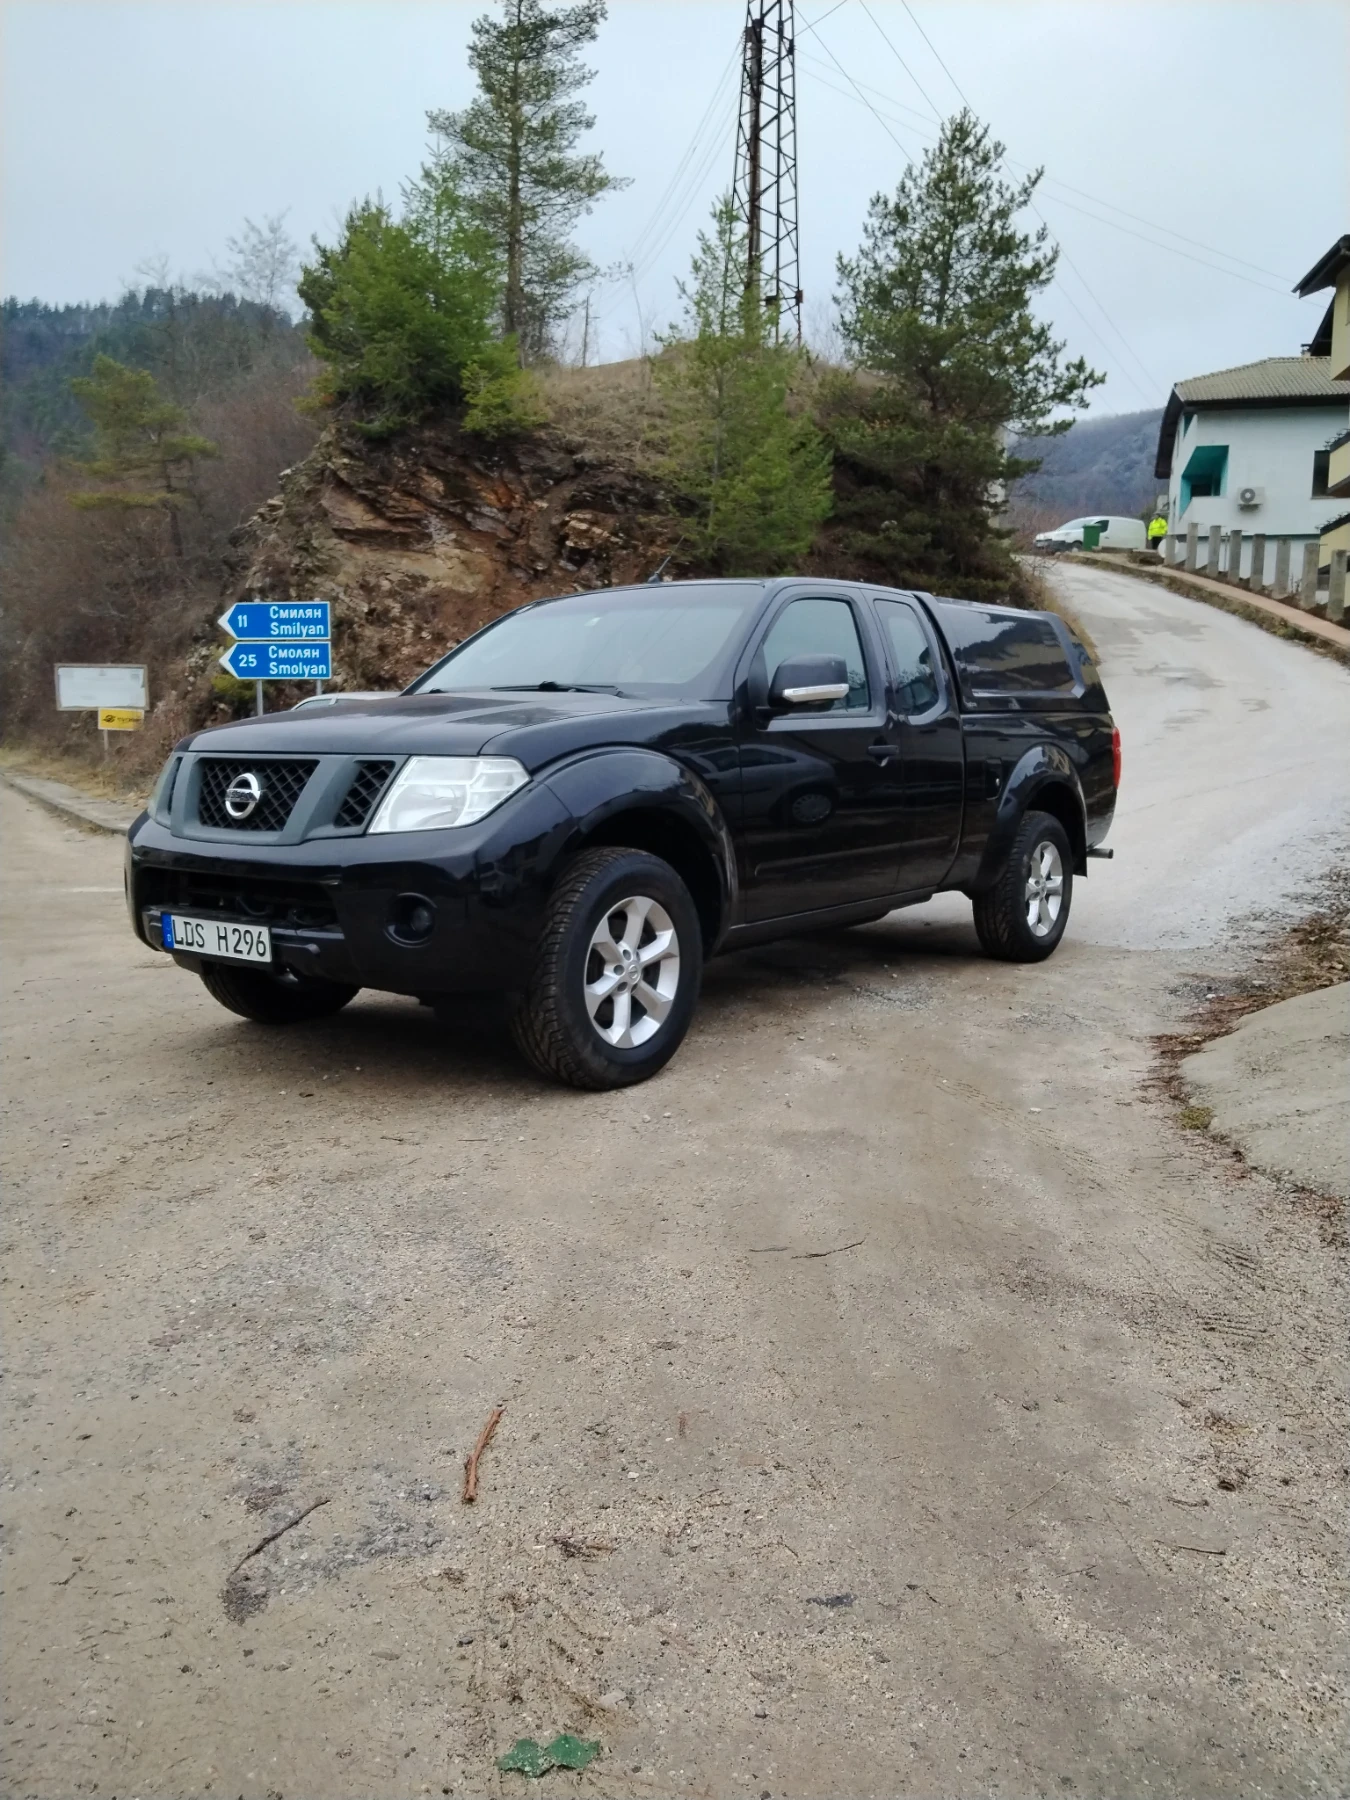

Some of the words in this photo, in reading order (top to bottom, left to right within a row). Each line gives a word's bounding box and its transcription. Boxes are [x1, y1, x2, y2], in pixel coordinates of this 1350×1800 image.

[269, 605, 322, 619] Смилян
[237, 614, 248, 628] 11
[270, 621, 324, 638] Smilyan
[268, 645, 320, 659] Смолян
[238, 654, 257, 668] 25
[269, 661, 327, 678] Smolyan
[172, 918, 205, 949] LDS
